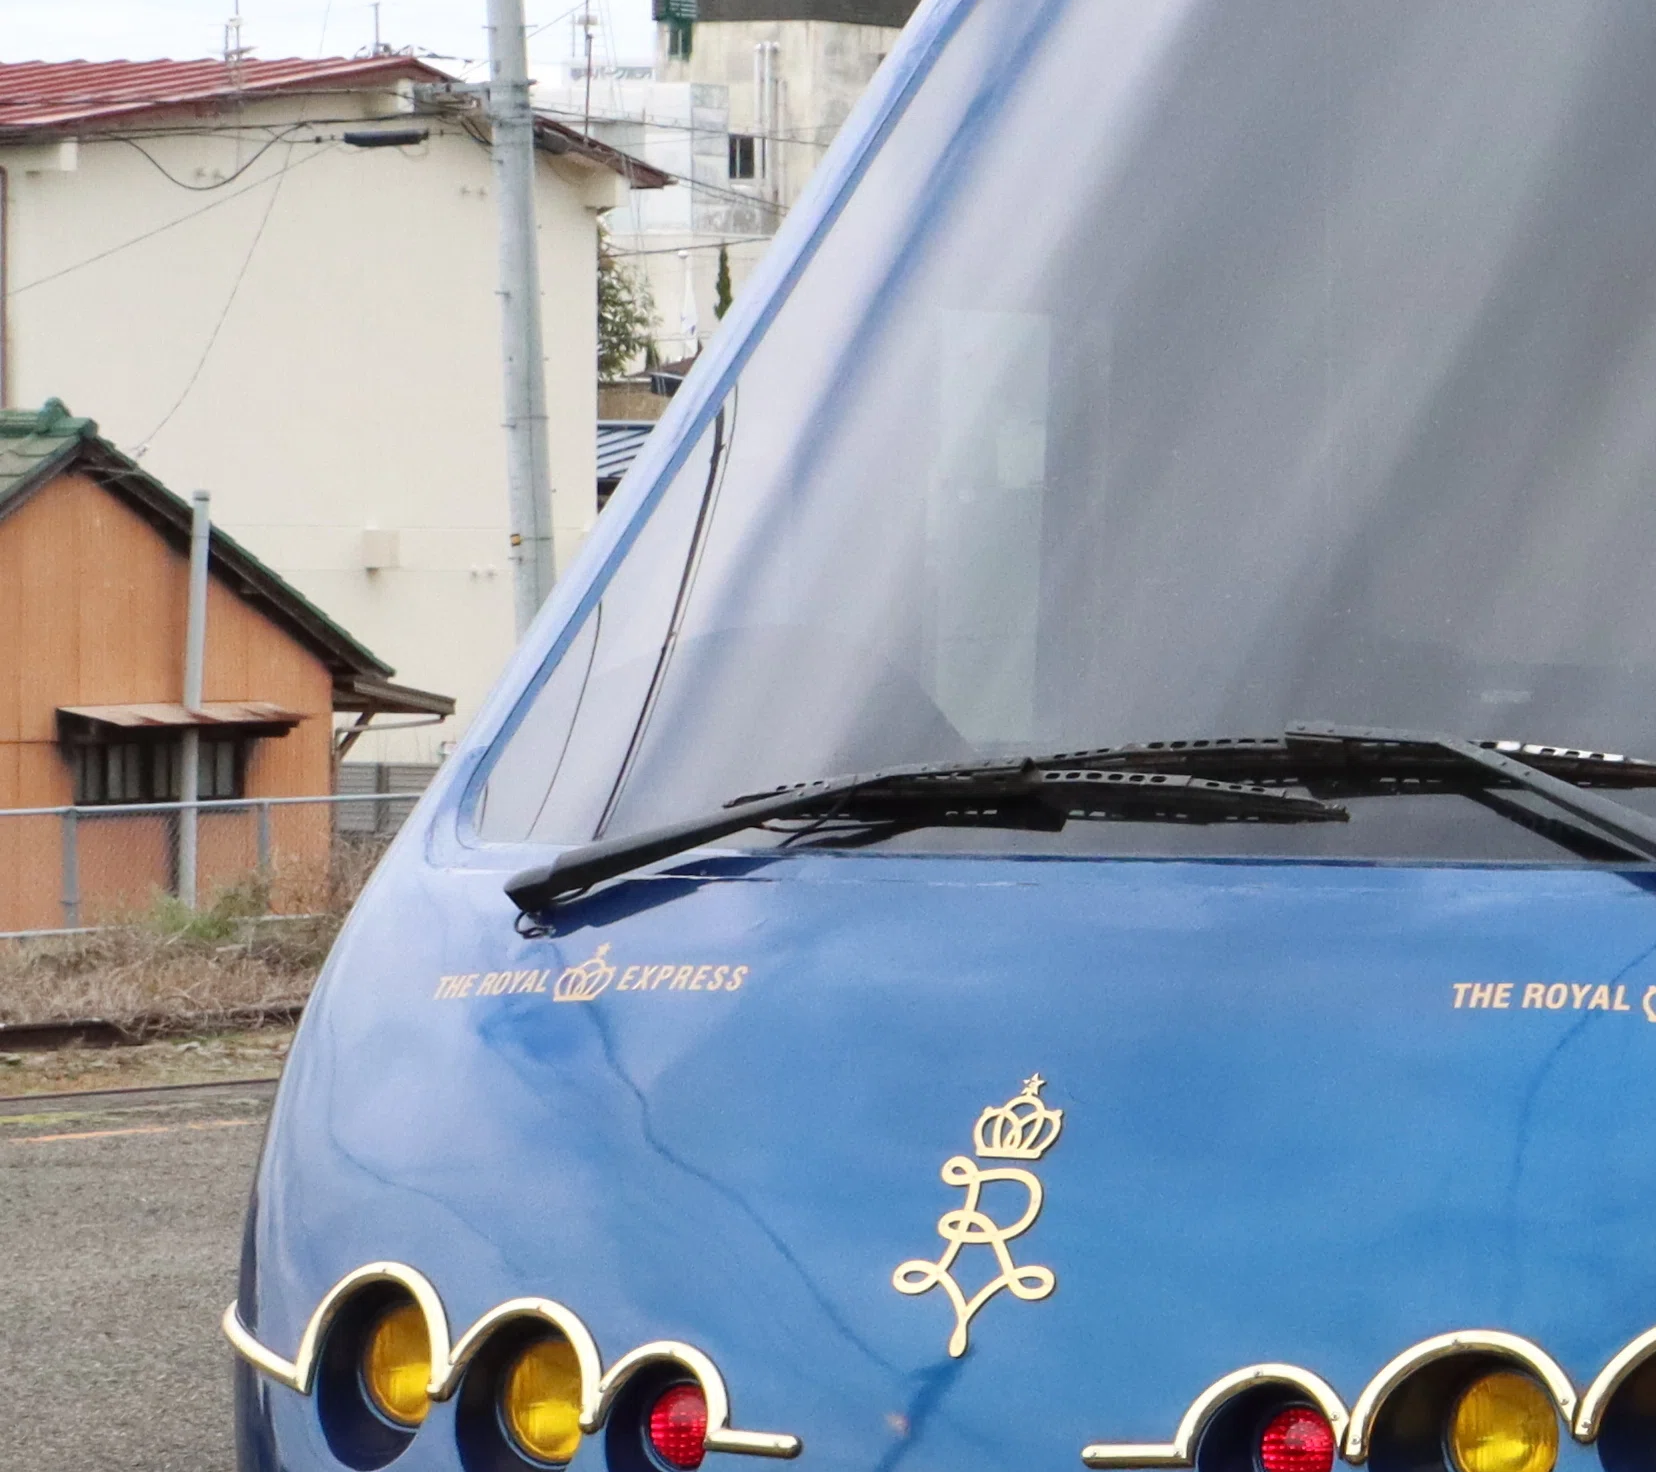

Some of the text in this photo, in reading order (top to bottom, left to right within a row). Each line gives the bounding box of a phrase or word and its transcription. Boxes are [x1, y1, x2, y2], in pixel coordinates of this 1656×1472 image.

[433, 964, 750, 1001] THE ROYAL EXPRESS
[1452, 981, 1516, 1010] THE
[1521, 982, 1631, 1012] ROYAL
